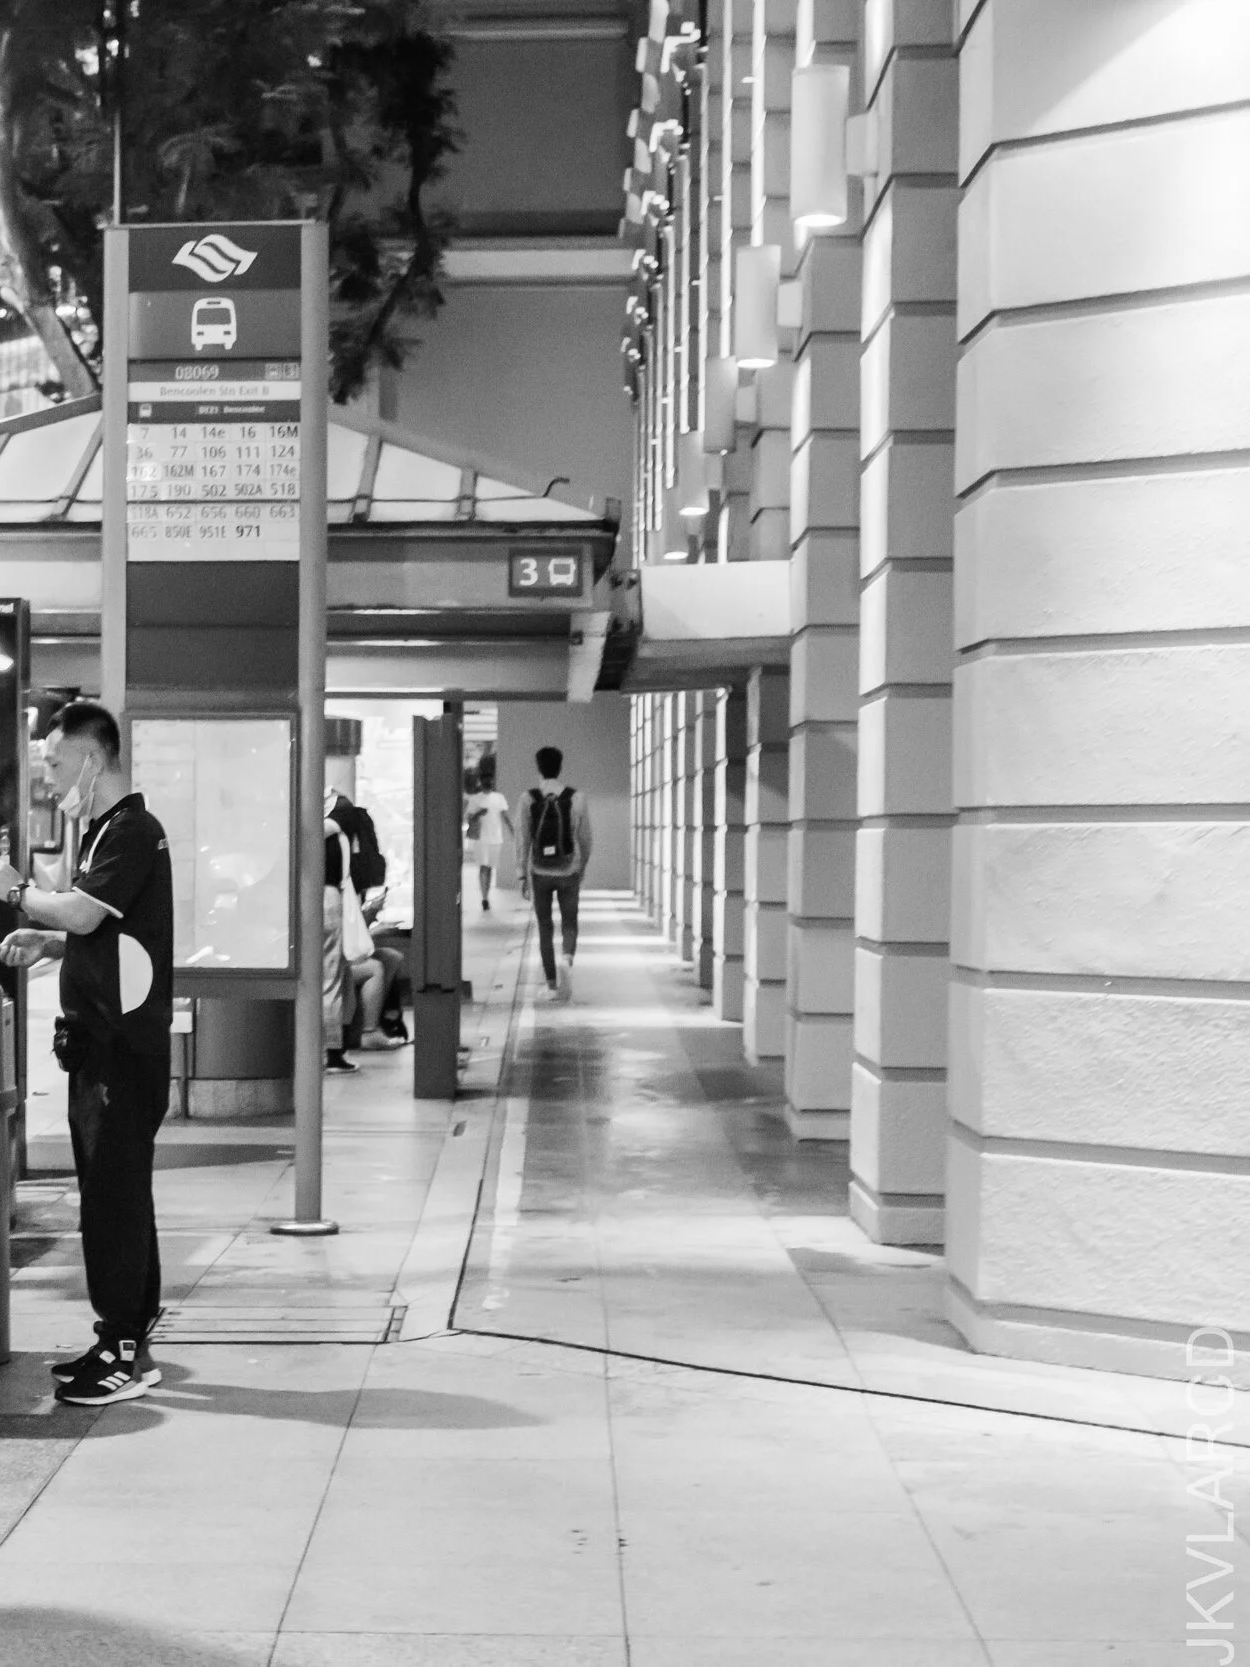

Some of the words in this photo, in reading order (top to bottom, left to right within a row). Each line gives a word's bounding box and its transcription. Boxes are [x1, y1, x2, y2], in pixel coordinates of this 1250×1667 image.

[174, 364, 220, 380] 08069
[141, 427, 150, 440] 7
[172, 426, 187, 440] 14
[202, 426, 226, 439] 14e
[240, 426, 256, 439] 16
[270, 425, 298, 439] 16M
[170, 445, 188, 458] 77
[201, 446, 227, 459] 106
[236, 445, 260, 459] 111
[271, 445, 295, 458] 124
[202, 465, 226, 478] 167
[236, 464, 261, 477] 174
[270, 463, 297, 477] 174e
[132, 485, 158, 498] 175
[168, 484, 191, 497] 190
[202, 484, 227, 498] 502
[270, 483, 296, 496] 518
[236, 525, 261, 538] 971
[519, 557, 539, 587] 3
